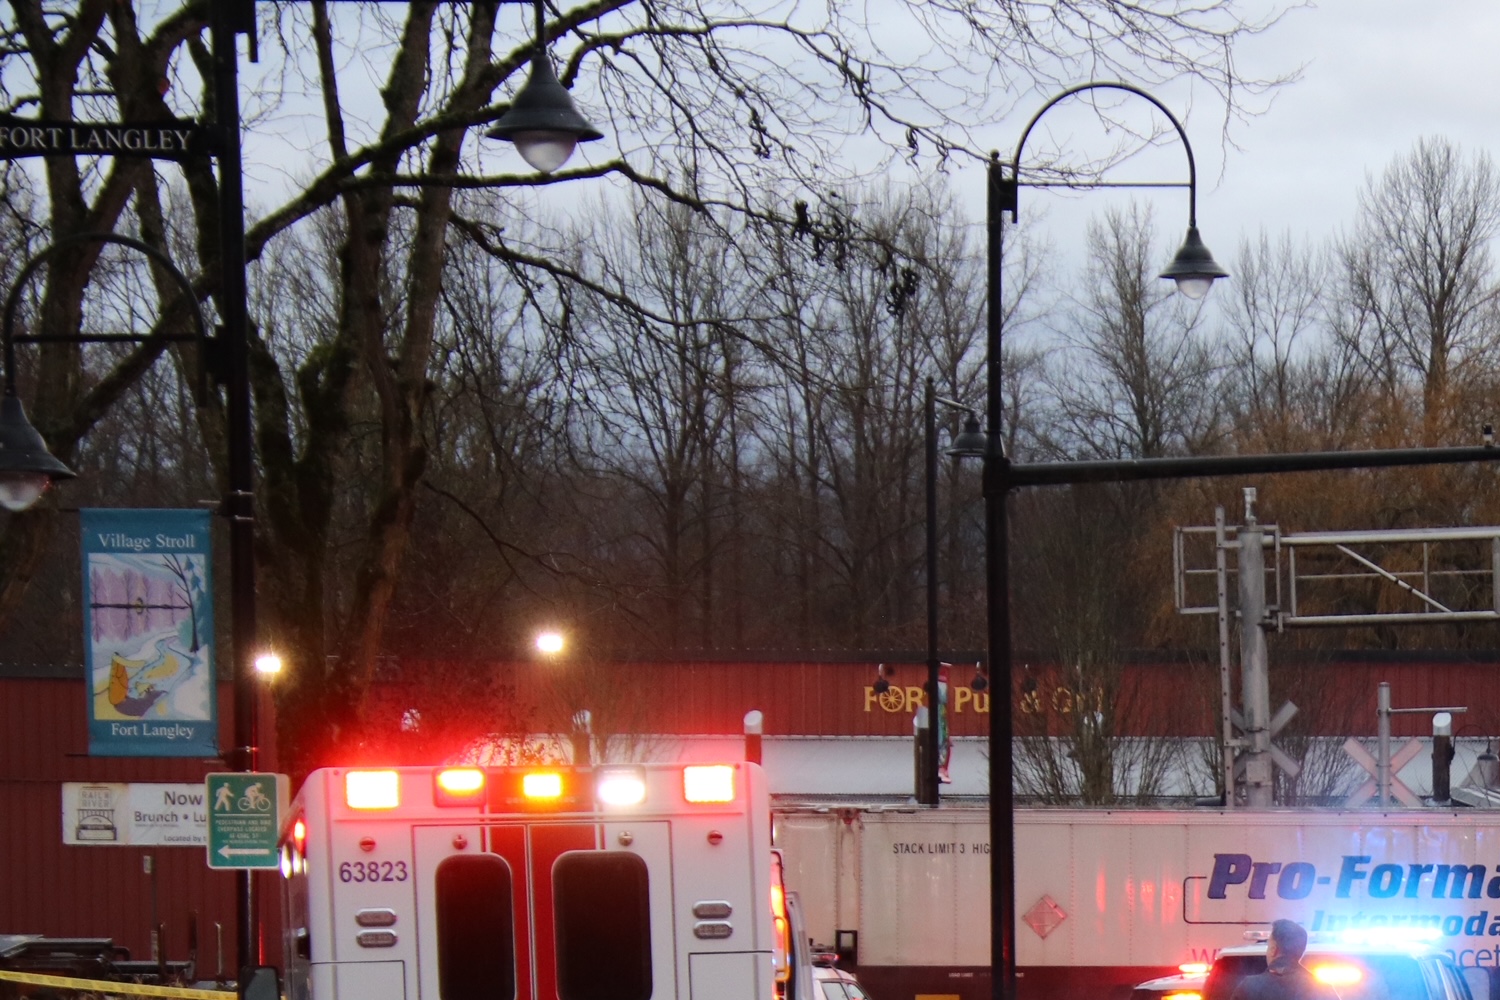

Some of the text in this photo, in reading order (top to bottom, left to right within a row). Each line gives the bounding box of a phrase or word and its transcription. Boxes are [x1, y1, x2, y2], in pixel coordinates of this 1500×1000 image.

[0, 126, 191, 150] FORT LANGLEY
[98, 533, 195, 551] Village Stroll
[863, 686, 926, 713] FOR
[954, 686, 990, 713] Pu
[111, 722, 195, 740] Fort Langley
[164, 791, 203, 806] Now
[134, 810, 206, 823] Brunch Lu
[893, 843, 991, 854] STACK LIMIT 3 HIG
[339, 860, 408, 883] 63823
